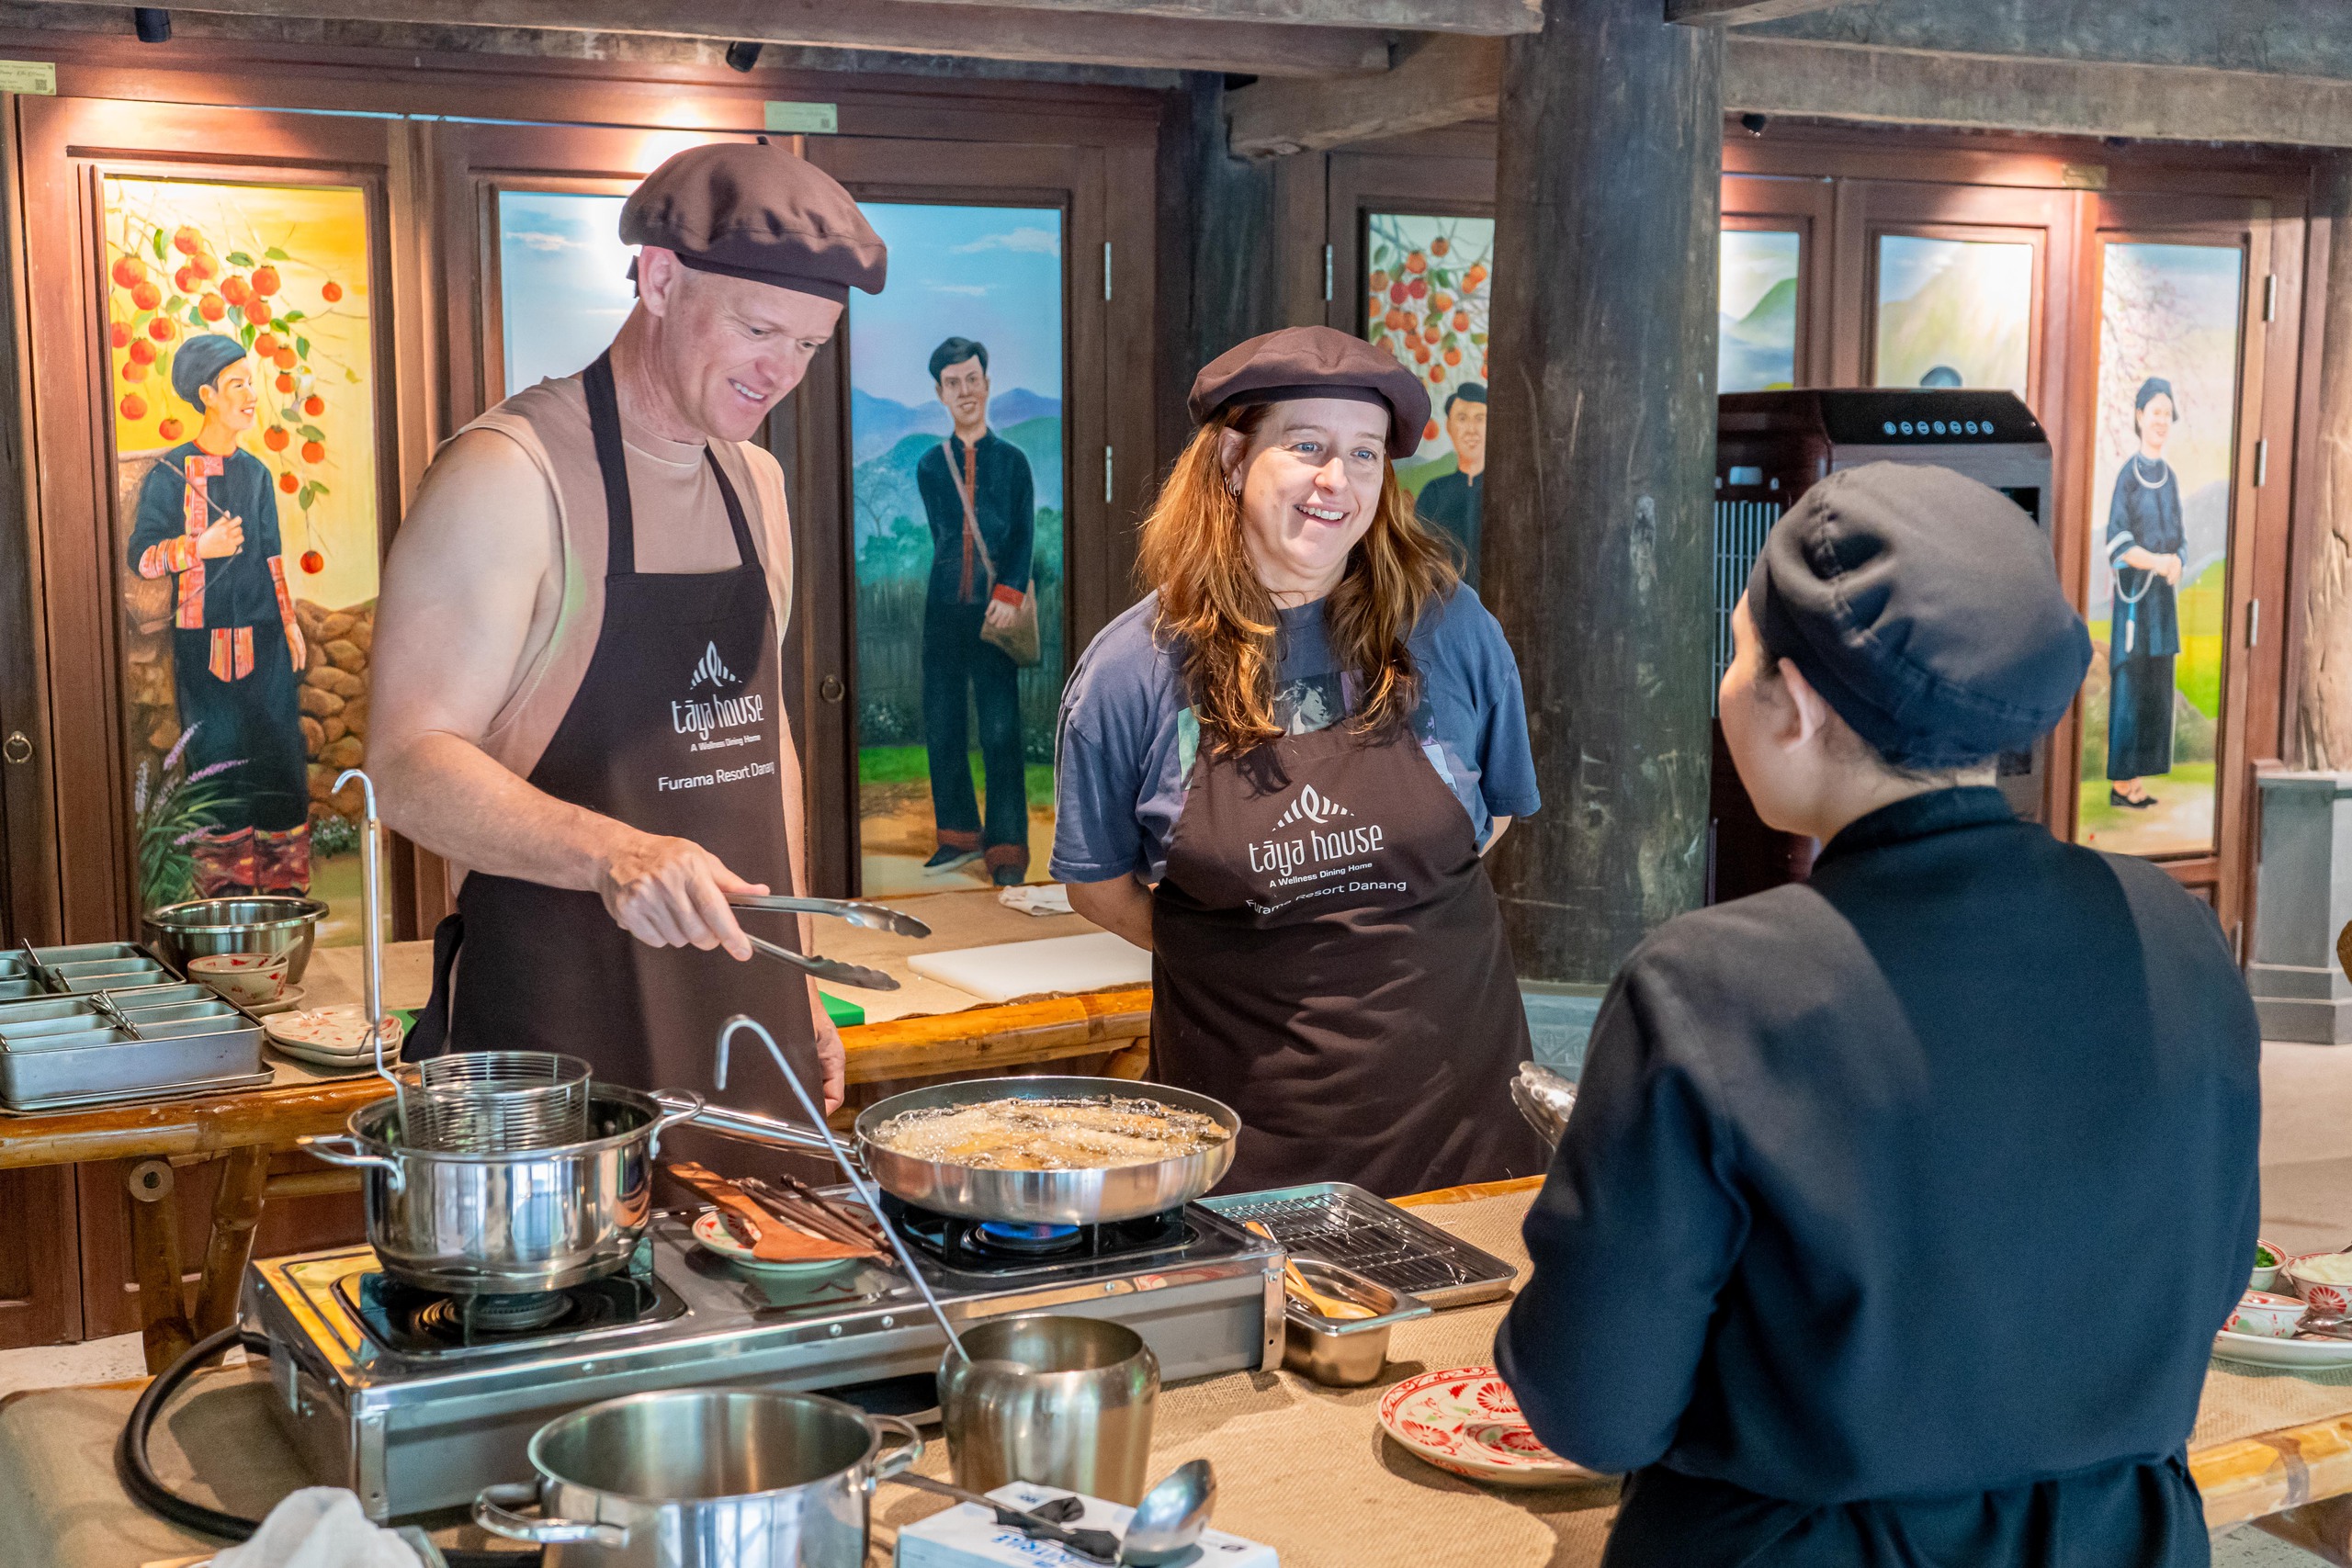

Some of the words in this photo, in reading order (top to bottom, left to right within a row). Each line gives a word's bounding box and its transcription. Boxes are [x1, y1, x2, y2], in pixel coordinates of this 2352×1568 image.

[713, 694, 764, 728] house
[690, 743, 698, 752] A
[658, 774, 714, 791] Furama
[716, 765, 752, 784] Resort
[1310, 825, 1385, 862] house
[1269, 880, 1277, 888] A
[1278, 874, 1317, 886] Wellness
[1319, 867, 1346, 878] Dining
[1348, 862, 1373, 874] Home
[1295, 885, 1345, 901] Resort
[1349, 881, 1408, 892] Danang
